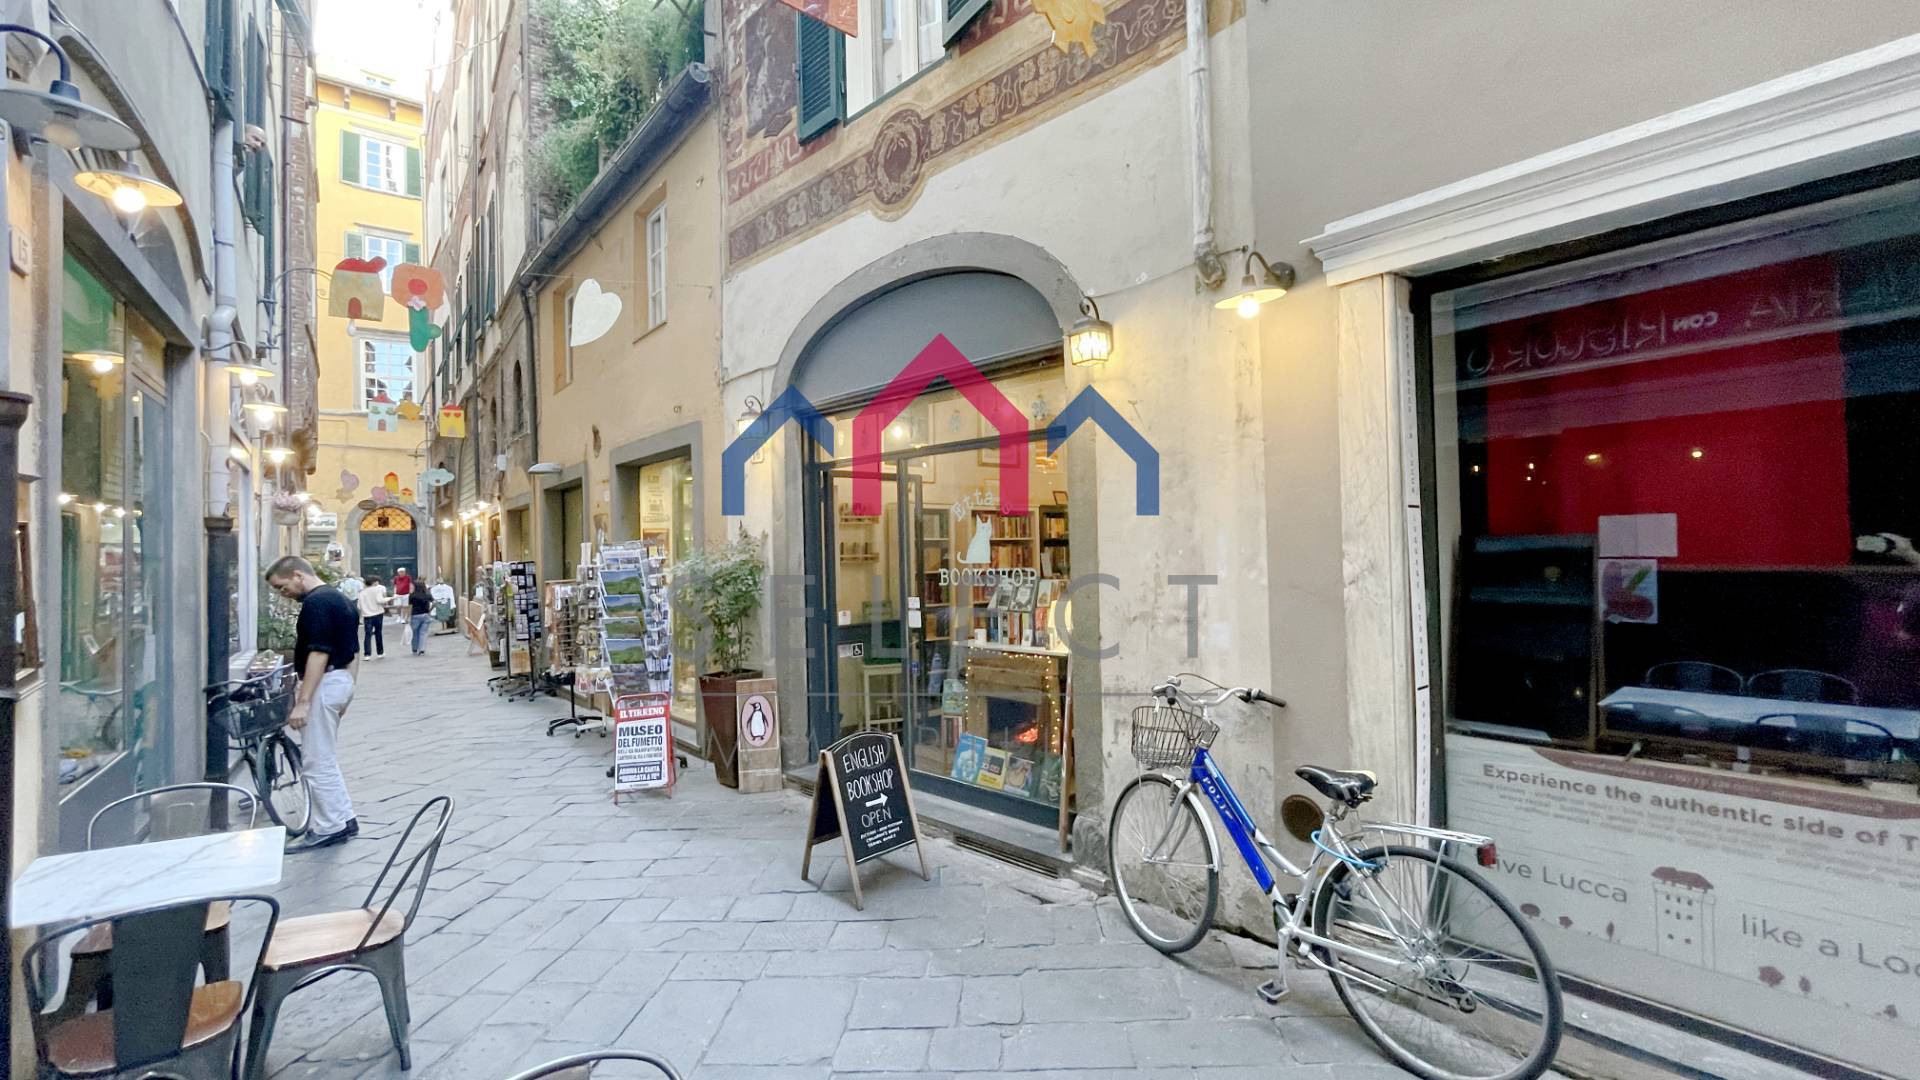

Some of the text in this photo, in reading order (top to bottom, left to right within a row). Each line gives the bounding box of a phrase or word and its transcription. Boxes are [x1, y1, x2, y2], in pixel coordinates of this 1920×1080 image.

[938, 567, 1037, 588] BOOKSHOP
[628, 707, 665, 718] TIRRENO
[617, 736, 662, 748] DEL FUMETTO
[619, 725, 662, 737] MUSEO
[842, 744, 886, 773] ENGLISH
[846, 768, 893, 801] BOOKSHOP
[861, 806, 892, 828] OPEN
[1482, 763, 1598, 796] Experience
[1604, 784, 1642, 804] the
[1650, 794, 1773, 828] authentic
[1783, 815, 1844, 839] side
[1855, 830, 1889, 847] of
[1495, 856, 1628, 903] ive Lucca
[1742, 913, 1803, 949] like
[1818, 939, 1840, 958] a
